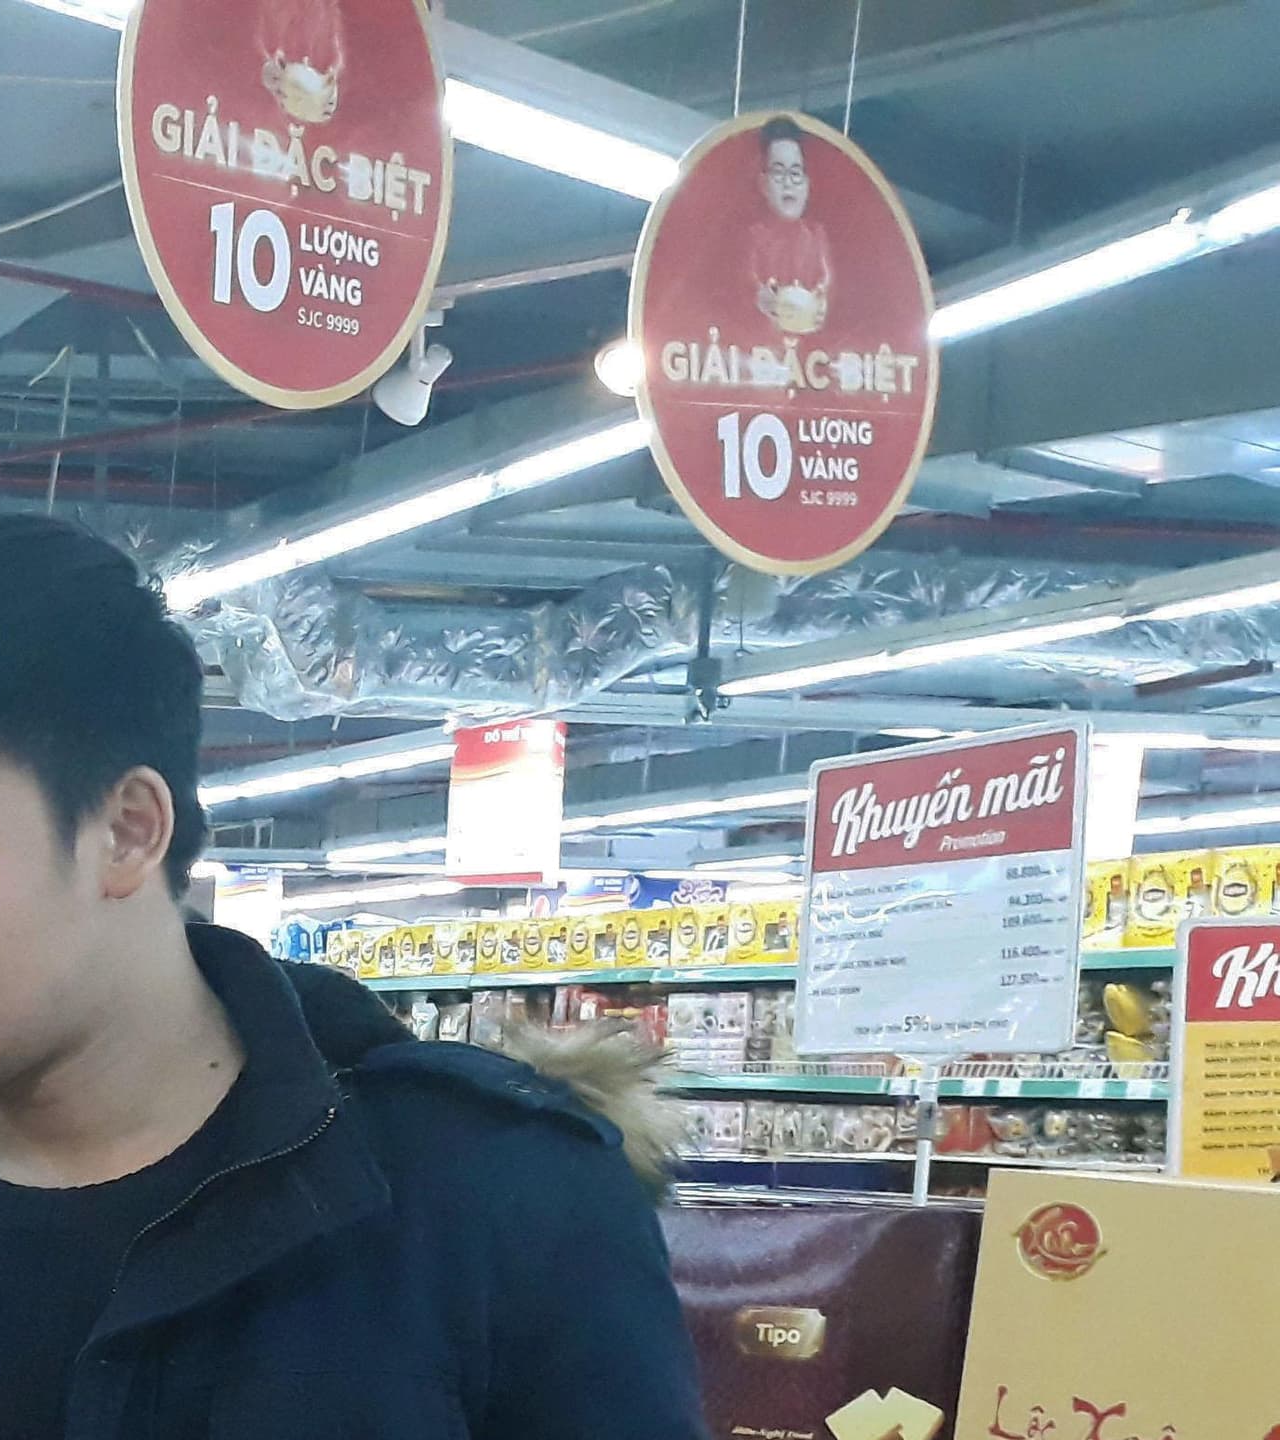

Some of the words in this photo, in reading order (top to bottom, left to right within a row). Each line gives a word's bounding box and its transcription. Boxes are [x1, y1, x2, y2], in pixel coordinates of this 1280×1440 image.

[152, 95, 240, 168] GIẢI
[252, 122, 338, 198] ĐẶC
[348, 152, 431, 222] BIỆT
[210, 201, 291, 312] 10
[300, 223, 380, 267] LƯỢNG
[299, 264, 362, 306] VÀNG
[297, 307, 323, 329] SJC
[327, 313, 360, 336] 9999
[661, 326, 739, 383] GIẢI
[838, 343, 919, 403] BIỆT
[798, 416, 873, 448] LƯỢNG
[717, 411, 793, 501] 10
[799, 451, 859, 482] VÀNG
[800, 490, 823, 506] SJC
[831, 768, 973, 858] Khuyến
[977, 747, 1066, 819] mãi
[756, 1323, 801, 1348] Tipo
